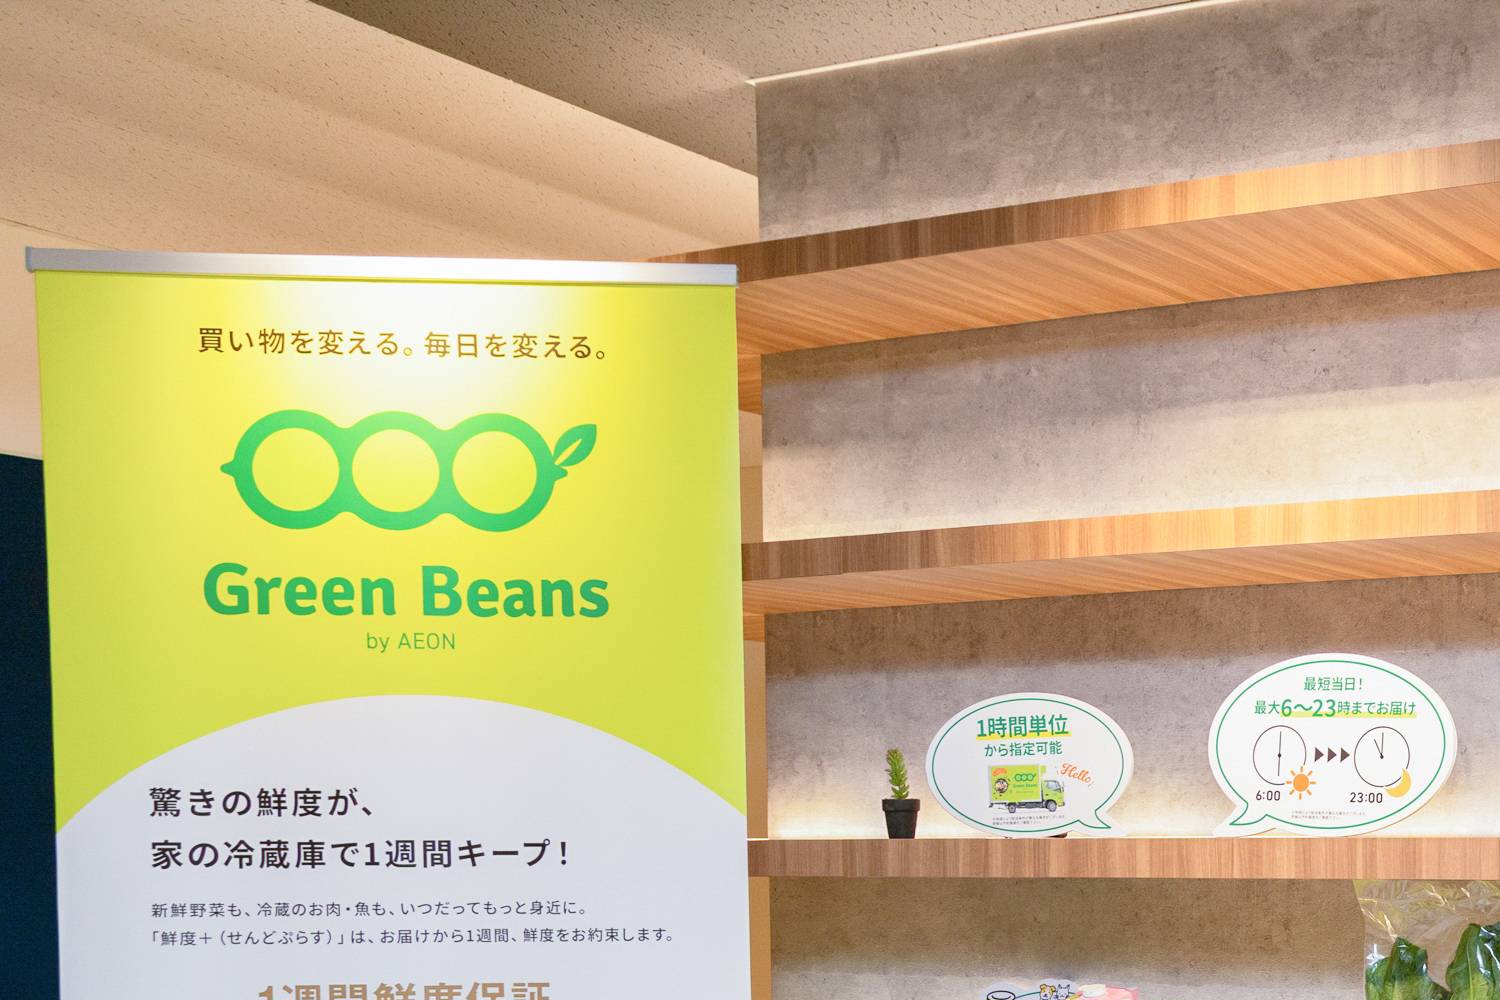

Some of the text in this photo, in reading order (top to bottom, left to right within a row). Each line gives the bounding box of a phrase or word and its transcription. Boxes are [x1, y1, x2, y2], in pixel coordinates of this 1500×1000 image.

[199, 327, 608, 361] 買い物を変える。毎日を変える。
[203, 562, 610, 618] Green Beans
[365, 631, 457, 653] by AEON
[1303, 676, 1364, 692] 最短当日！
[976, 714, 1070, 738] 1時間単位
[984, 741, 1063, 758] から指定可能
[149, 787, 375, 818] 驚きの鮮度が、
[1255, 790, 1281, 801] 6:00
[1349, 792, 1383, 804] 23:00
[151, 838, 569, 870] 家の冷蔵庫で1週間キープ！
